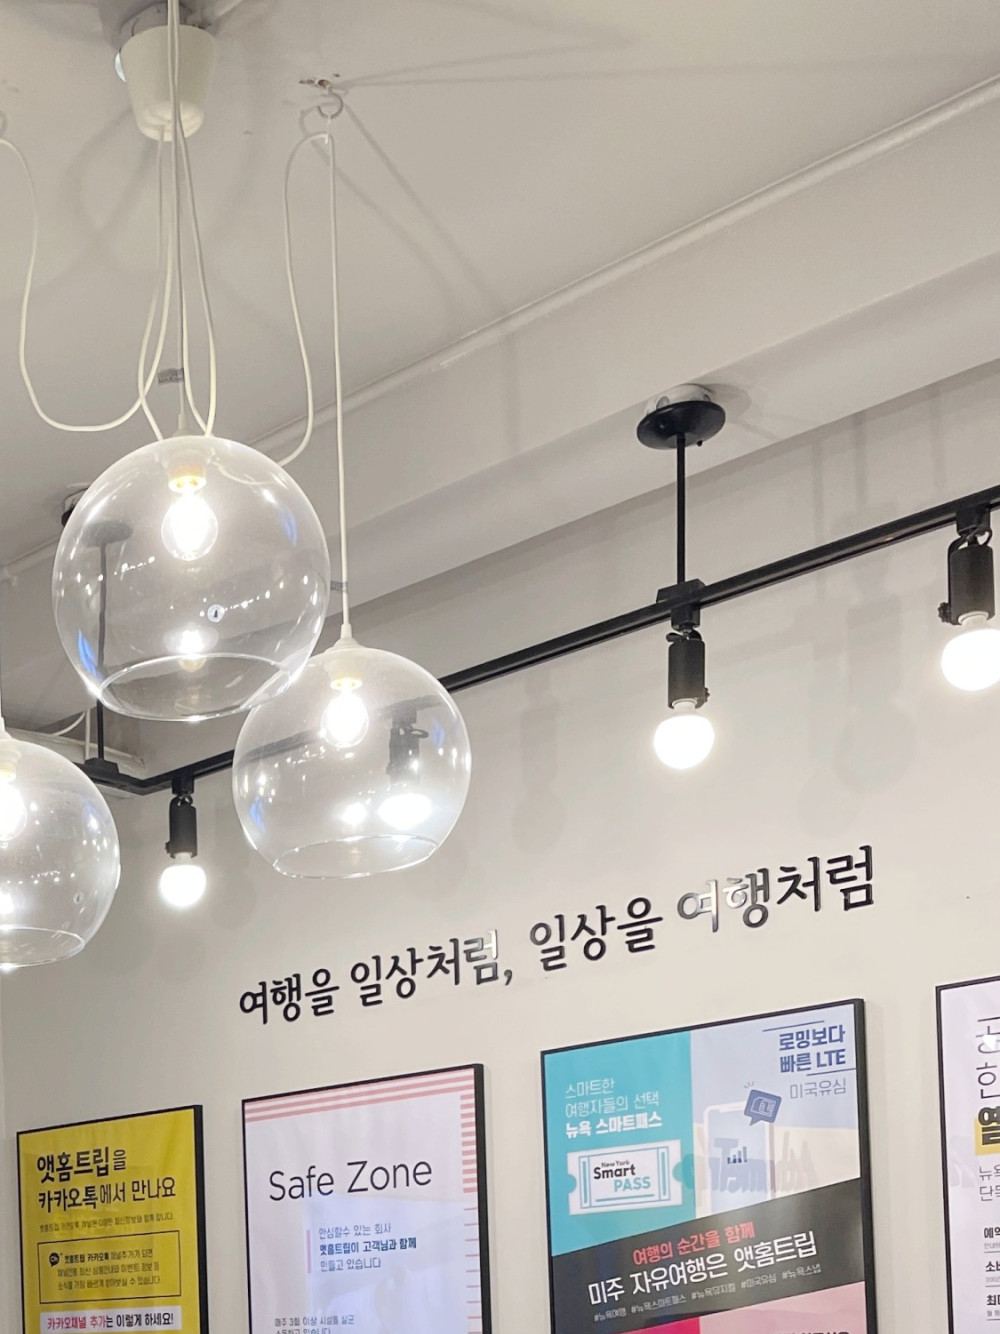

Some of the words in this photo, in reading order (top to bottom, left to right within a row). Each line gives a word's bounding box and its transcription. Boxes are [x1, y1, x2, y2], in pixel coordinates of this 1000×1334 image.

[239, 968, 340, 1025] 여행을
[350, 928, 513, 1007] 일상처럼,
[529, 896, 664, 972] 일상을
[676, 844, 875, 933] 여행처럼
[779, 1024, 846, 1052] 로밍보다
[779, 1052, 812, 1073] 빠른
[816, 1048, 846, 1068] LTE
[565, 1078, 615, 1099] 스마트한
[789, 1078, 846, 1099] 미국유심
[565, 1095, 628, 1118] 여행자들의
[634, 1091, 659, 1109] 선택
[565, 1120, 592, 1139] 뉴욕
[595, 1111, 663, 1135] 스마트패스
[36, 1146, 127, 1184] 앳홈트립을
[593, 1164, 636, 1180] Smart
[269, 1165, 335, 1201] Safe
[346, 1160, 433, 1193] Zone
[614, 1176, 651, 1192] PASS
[38, 1181, 126, 1213] 카카오톡에서
[132, 1177, 176, 1202] 만나요
[318, 1227, 350, 1240] 안심할수
[353, 1225, 372, 1236] 있는
[374, 1222, 392, 1235] 회사
[632, 1242, 673, 1267] 여행의
[677, 1230, 721, 1255] 순간을
[725, 1221, 756, 1244] 함께
[363, 1239, 397, 1253] 고객님과
[399, 1237, 417, 1249] 함께
[346, 1257, 382, 1270] 있습니다
[588, 1277, 625, 1305] 미주
[630, 1253, 728, 1295] 자유여행은
[733, 1230, 818, 1272] 앳홈트립
[47, 1316, 87, 1330] 카카오채널
[90, 1315, 114, 1328] 추가는
[116, 1313, 143, 1328] 이렇게
[144, 1312, 174, 1327] 하세요!
